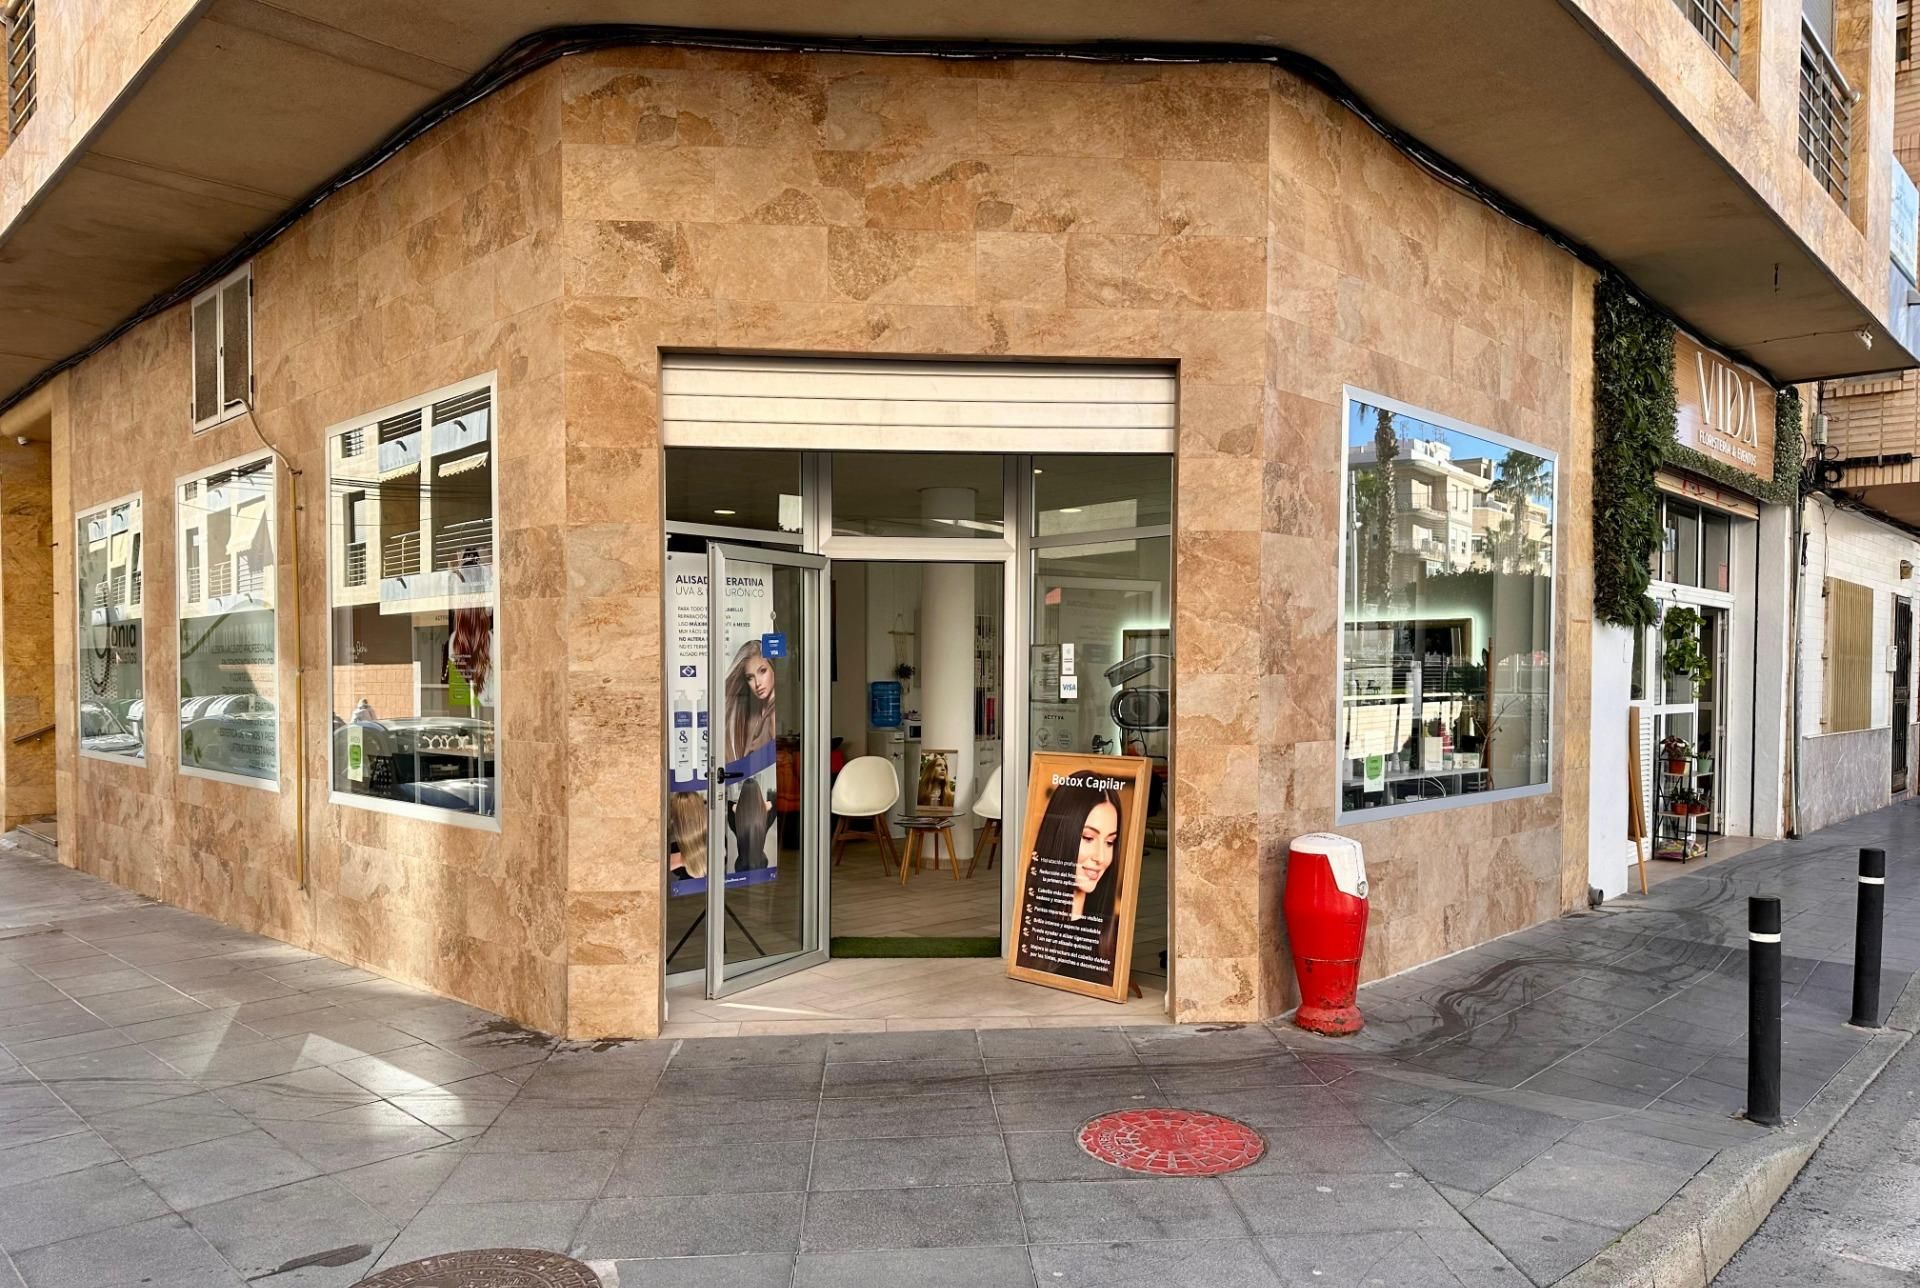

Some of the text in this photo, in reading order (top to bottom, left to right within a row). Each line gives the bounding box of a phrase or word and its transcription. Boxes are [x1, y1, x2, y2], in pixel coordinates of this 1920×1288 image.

[1695, 350, 1758, 449] VIDA
[1737, 446, 1757, 467] EVENTOS
[725, 577, 764, 586] ERATINA
[676, 586, 694, 596] UVA
[697, 587, 704, 596] &
[1052, 774, 1126, 795] Botox Capilar
[1081, 926, 1101, 935] saludable
[1074, 935, 1099, 945] ligeramente
[1078, 953, 1094, 962] cabello
